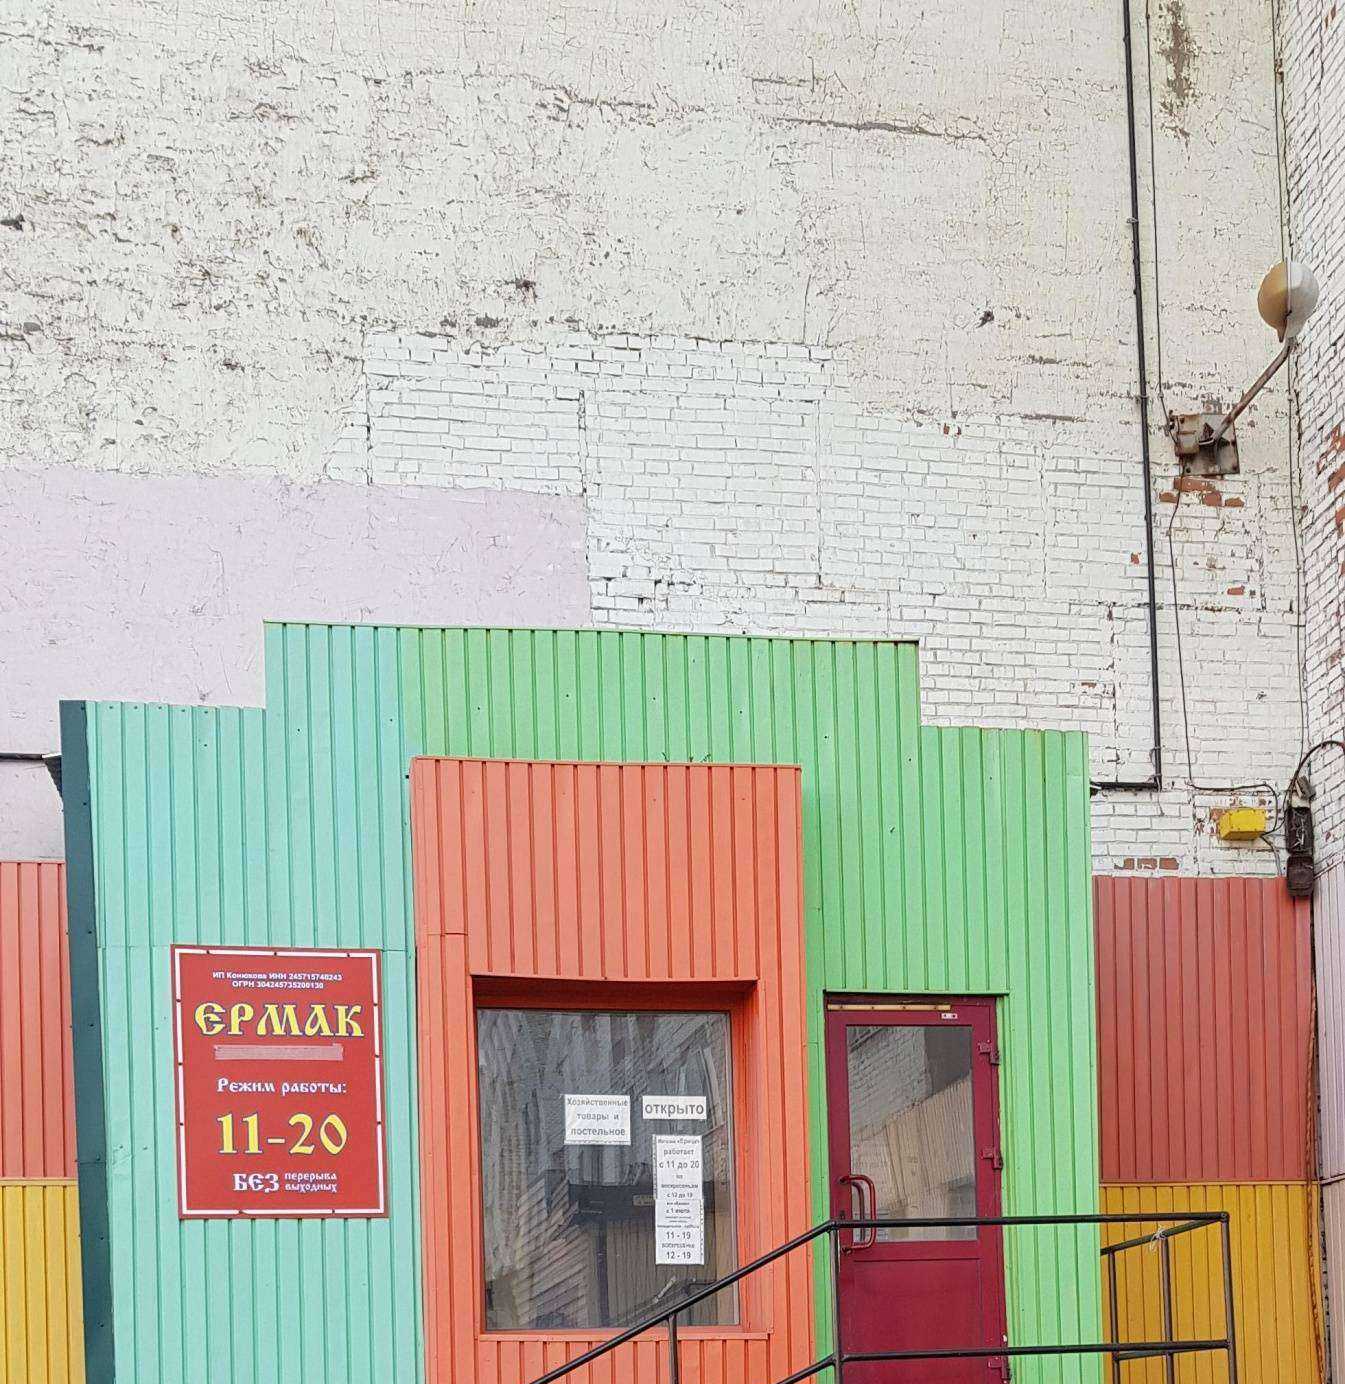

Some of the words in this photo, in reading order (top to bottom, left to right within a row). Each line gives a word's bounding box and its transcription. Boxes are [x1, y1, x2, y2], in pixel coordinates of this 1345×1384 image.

[212, 971, 224, 979] ИП
[232, 980, 255, 988] ОГРН
[194, 1001, 365, 1038] ЕРМАК
[216, 1077, 275, 1094] Режим
[567, 1097, 629, 1107] Хозяйственные
[645, 1103, 704, 1118] открыто
[576, 1113, 609, 1122] товары
[613, 1113, 620, 1121] и
[571, 1128, 626, 1136] постельное
[663, 1147, 695, 1158] работает
[658, 1161, 664, 1169] с
[666, 1160, 675, 1169] 11
[677, 1161, 688, 1170] до
[690, 1160, 700, 1169] 20
[232, 1172, 280, 1193] БЕЗ
[666, 1251, 675, 1260] 12
